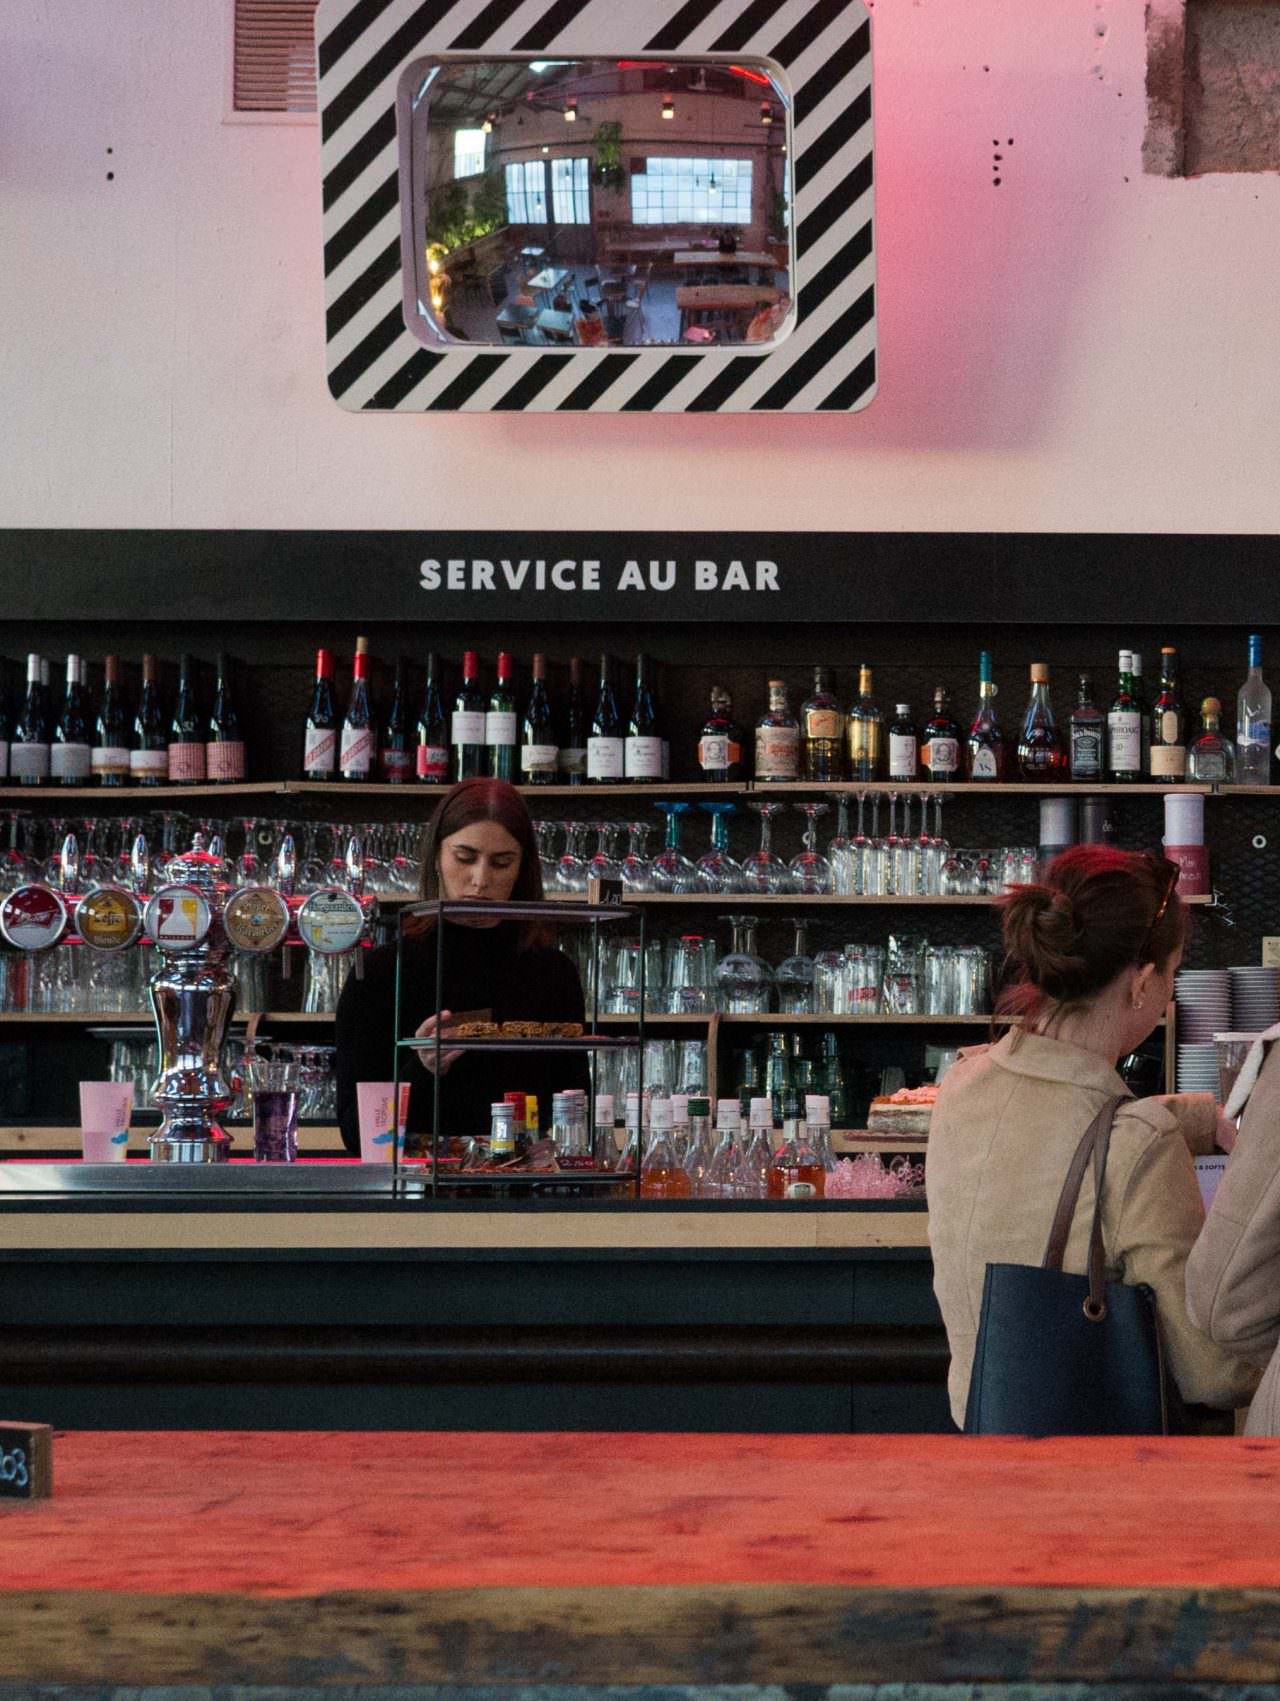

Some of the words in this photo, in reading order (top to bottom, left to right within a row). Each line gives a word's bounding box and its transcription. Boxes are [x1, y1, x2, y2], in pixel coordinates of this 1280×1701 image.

[419, 558, 600, 591] SERVICE
[616, 559, 677, 591] AU
[694, 559, 781, 591] BAR
